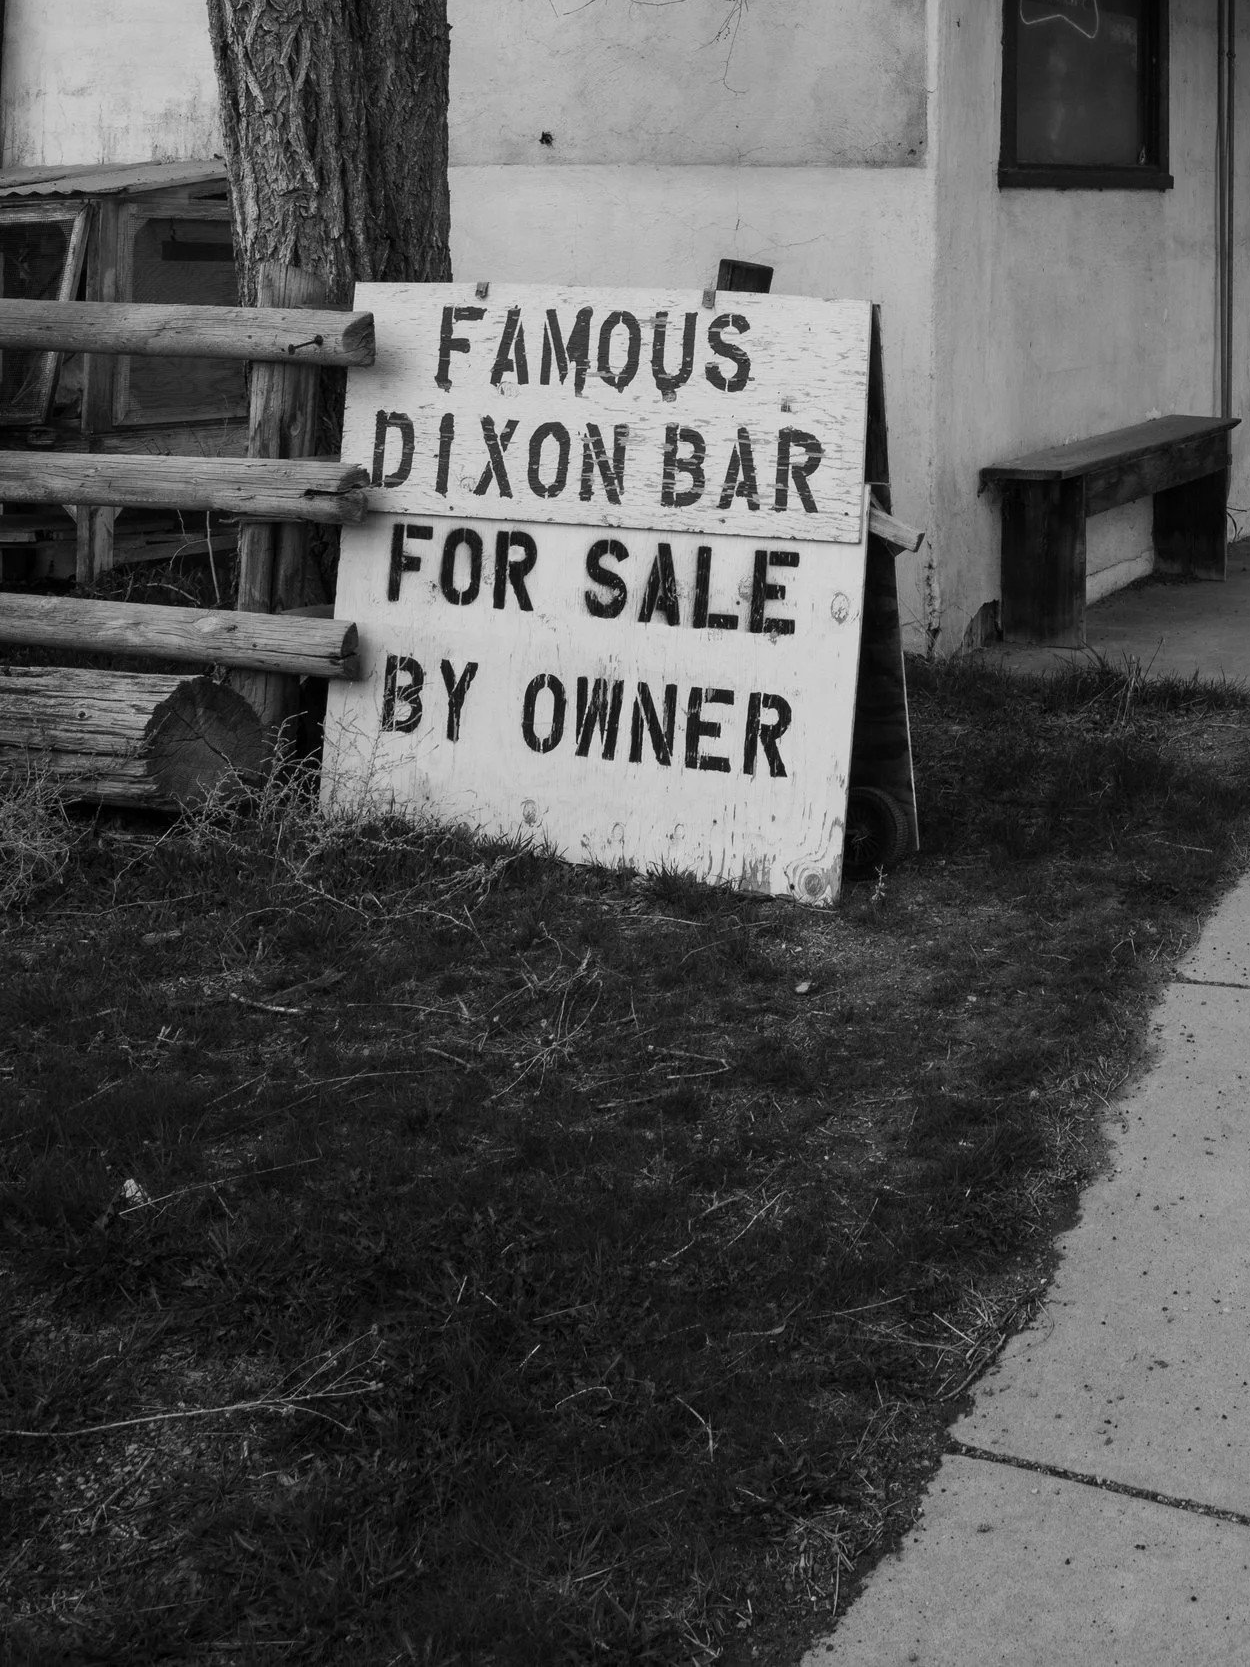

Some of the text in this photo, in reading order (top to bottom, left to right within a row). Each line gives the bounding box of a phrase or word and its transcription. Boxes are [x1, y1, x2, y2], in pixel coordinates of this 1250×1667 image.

[434, 304, 755, 399] FAMOUS
[371, 409, 826, 514] DIXON BAR
[387, 523, 801, 635] FOR SALE
[381, 654, 793, 778] BY OWNER
